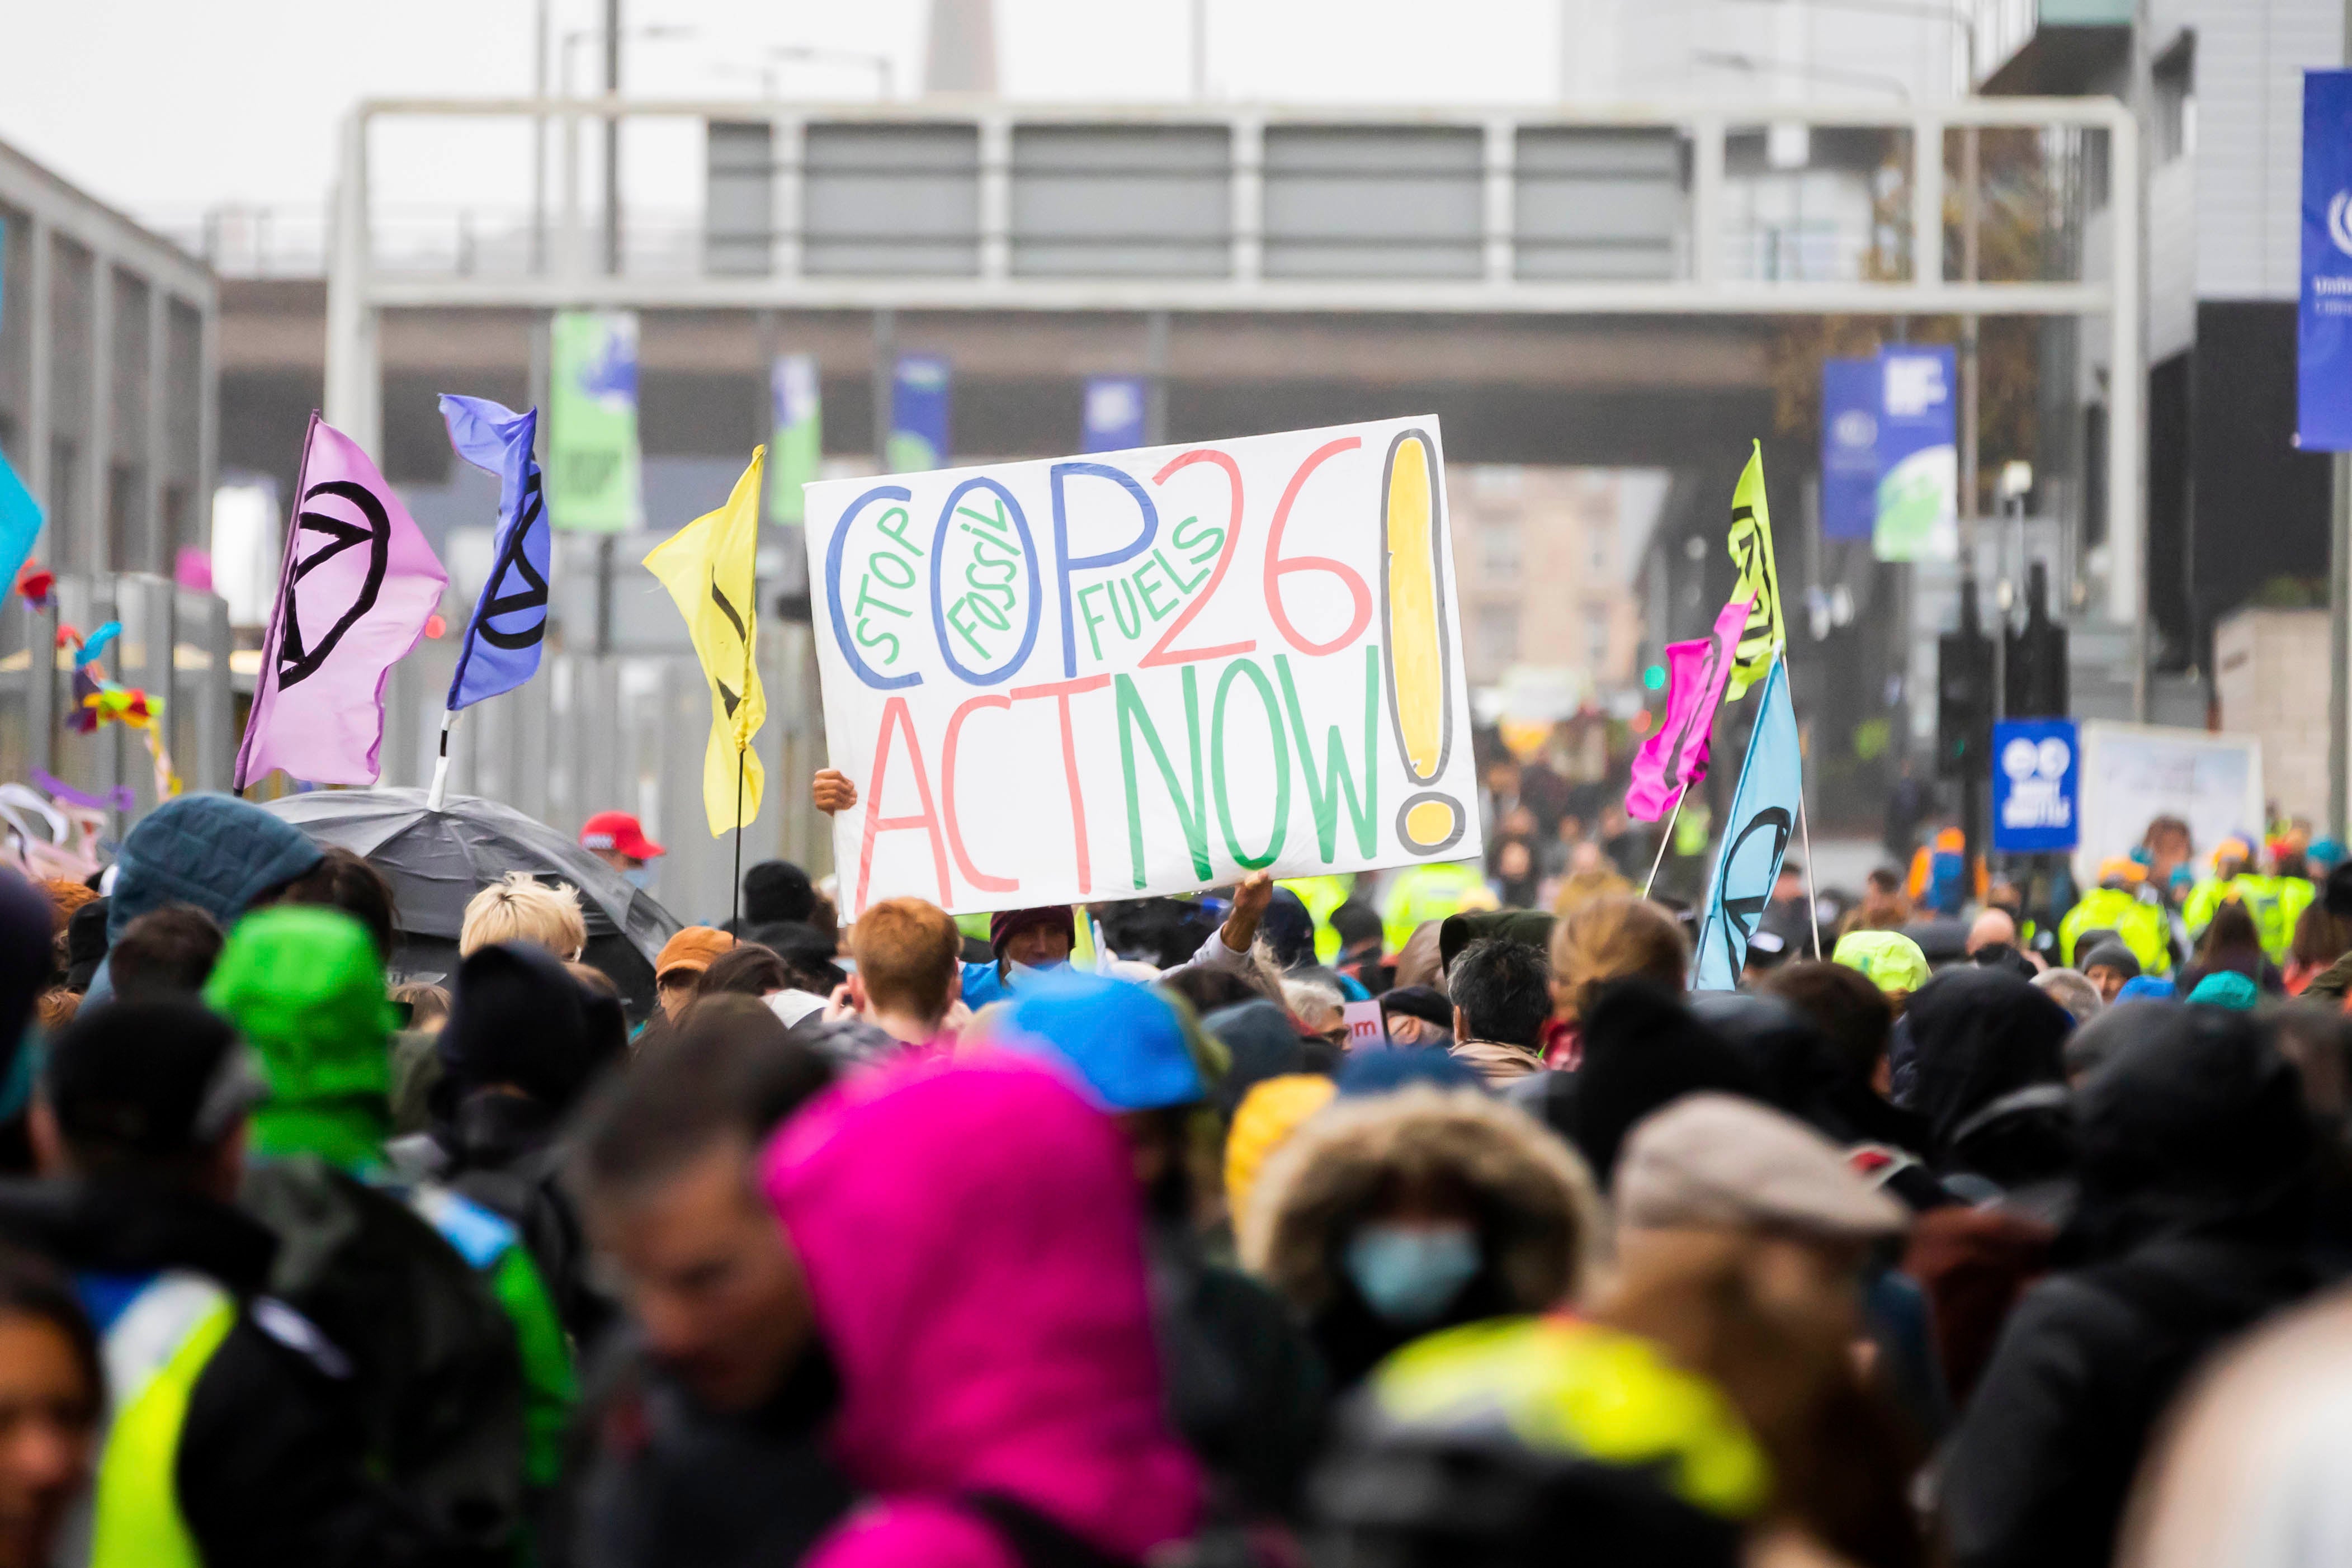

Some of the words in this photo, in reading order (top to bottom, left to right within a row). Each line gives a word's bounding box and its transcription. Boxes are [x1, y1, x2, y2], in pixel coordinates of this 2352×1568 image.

[855, 507, 924, 664] STOP
[1078, 516, 1225, 660] FUELS
[854, 673, 1111, 914] ACT
